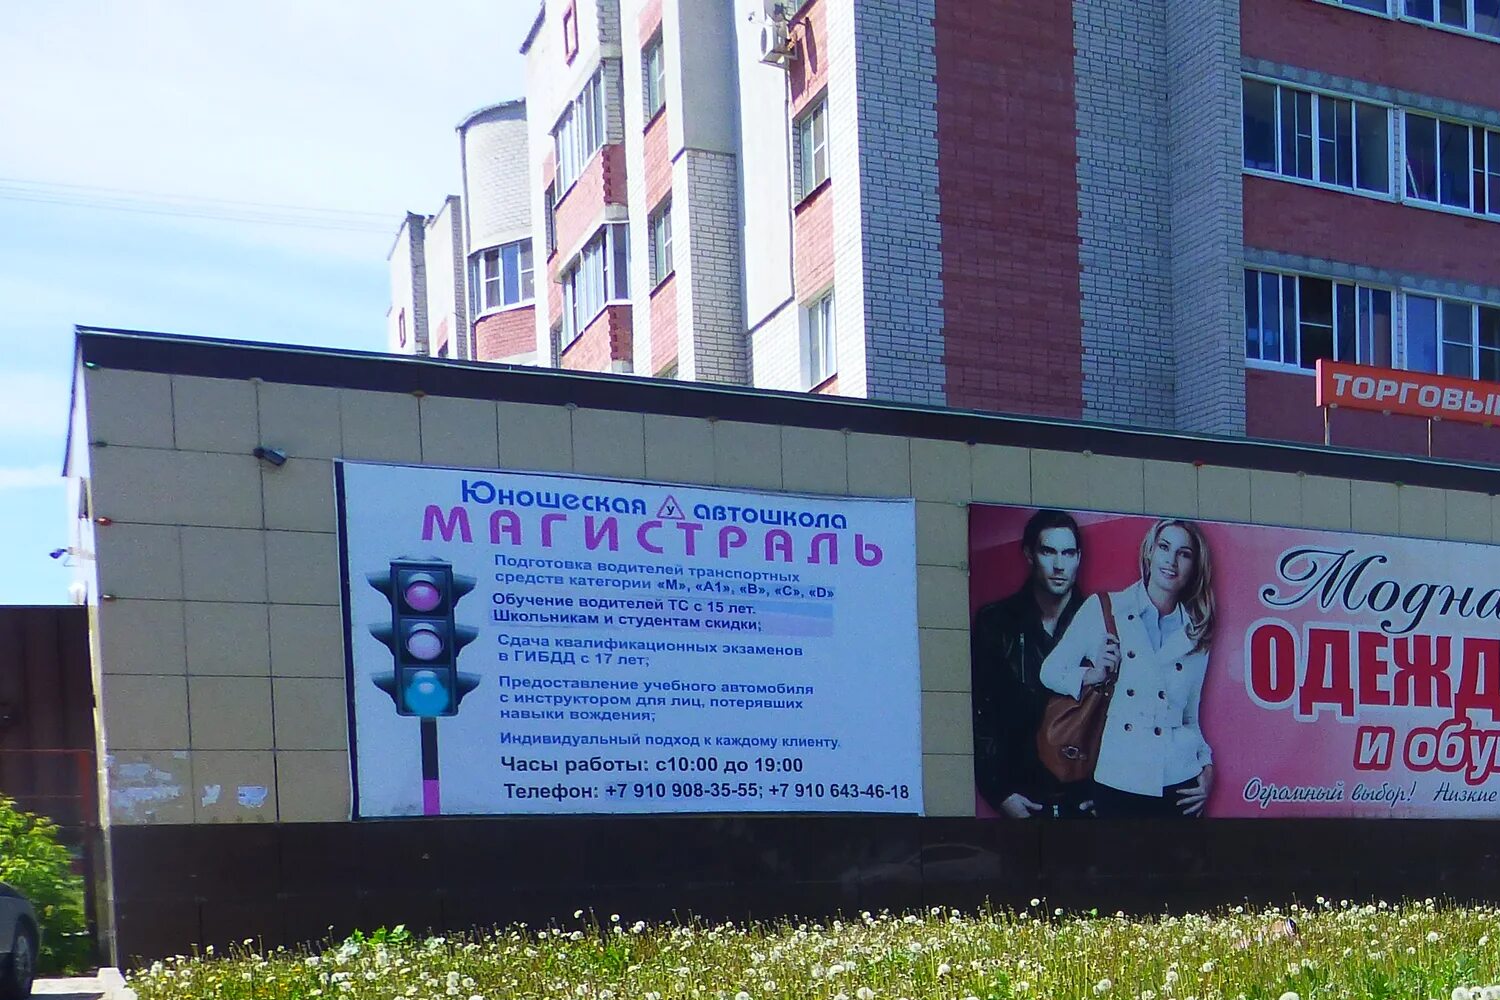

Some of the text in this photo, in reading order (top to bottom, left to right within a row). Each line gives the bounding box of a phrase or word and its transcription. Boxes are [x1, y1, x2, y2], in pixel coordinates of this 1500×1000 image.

[462, 480, 647, 515] Юношеская
[693, 503, 847, 529] автошкола
[421, 505, 883, 567] МАГИСТРАЛЬ
[495, 554, 800, 582] Подготовка водителей транспортных
[495, 573, 564, 584] средств
[569, 575, 651, 590] категории
[492, 592, 756, 614] Обучение водителей ТС с 15 лет.
[493, 609, 762, 632] Школьникам и студентам скидки;
[498, 634, 803, 656] Сдача квалификационных экзаменов
[498, 651, 650, 667] в ГИБДД с 17 лет;
[499, 676, 814, 695] Предоставление учебного автомобиля
[500, 694, 803, 710] с инструктором для лиц, потерявших
[500, 710, 656, 722] навыки вождения;
[500, 732, 840, 750] Индивидуальный подход к каждому клиенту.
[1355, 728, 1394, 769] и
[501, 756, 803, 774] Часы работы: с10:00 до 19:00
[504, 783, 909, 802] Телефон: +7 910 908-35-55; +7 910 643-46-18
[1243, 778, 1344, 809] Огромный
[1351, 781, 1416, 808] выбор!
[1433, 782, 1497, 802] Низкие
